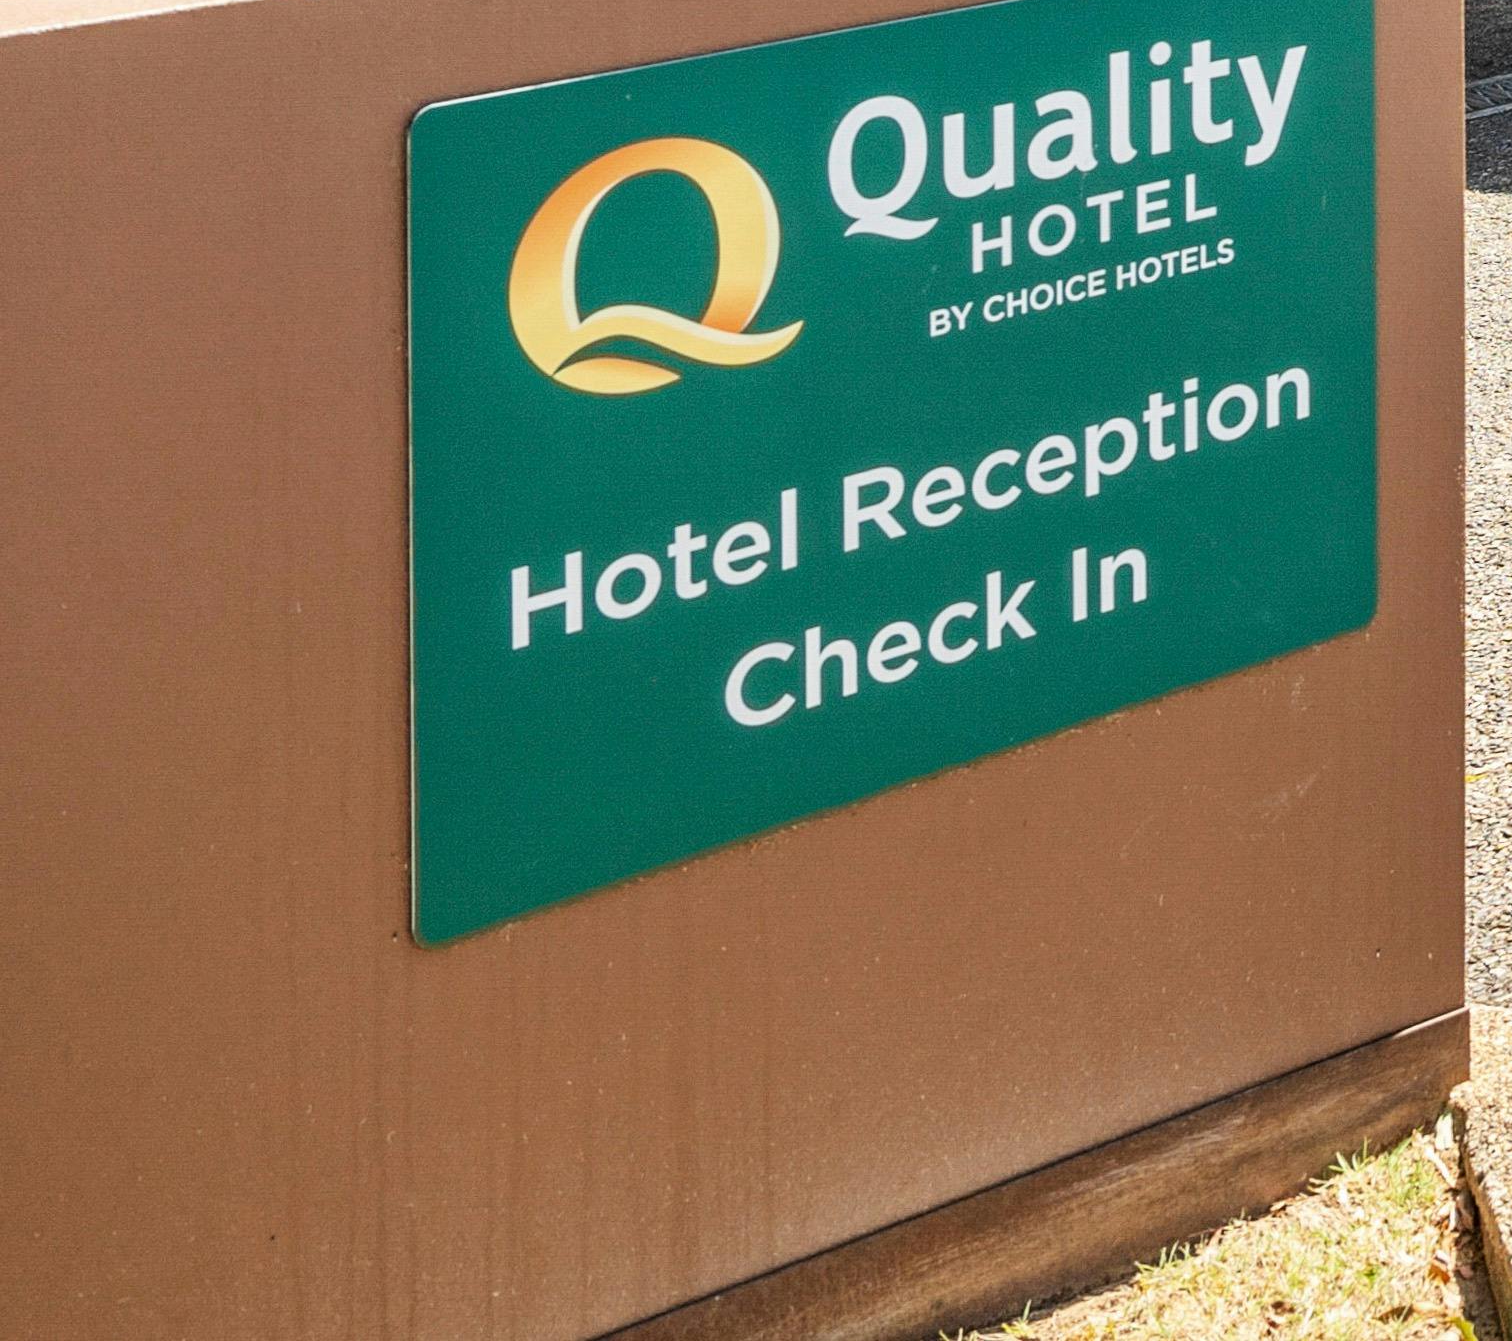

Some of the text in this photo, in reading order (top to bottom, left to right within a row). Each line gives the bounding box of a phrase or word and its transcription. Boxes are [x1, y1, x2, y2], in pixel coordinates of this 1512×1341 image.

[827, 39, 1307, 241] Quality
[972, 173, 1217, 273] HOTEL
[930, 238, 1235, 337] BY CHOICE HOTELS
[511, 367, 1311, 650] Hotel Reception
[725, 547, 1148, 726] Check In
